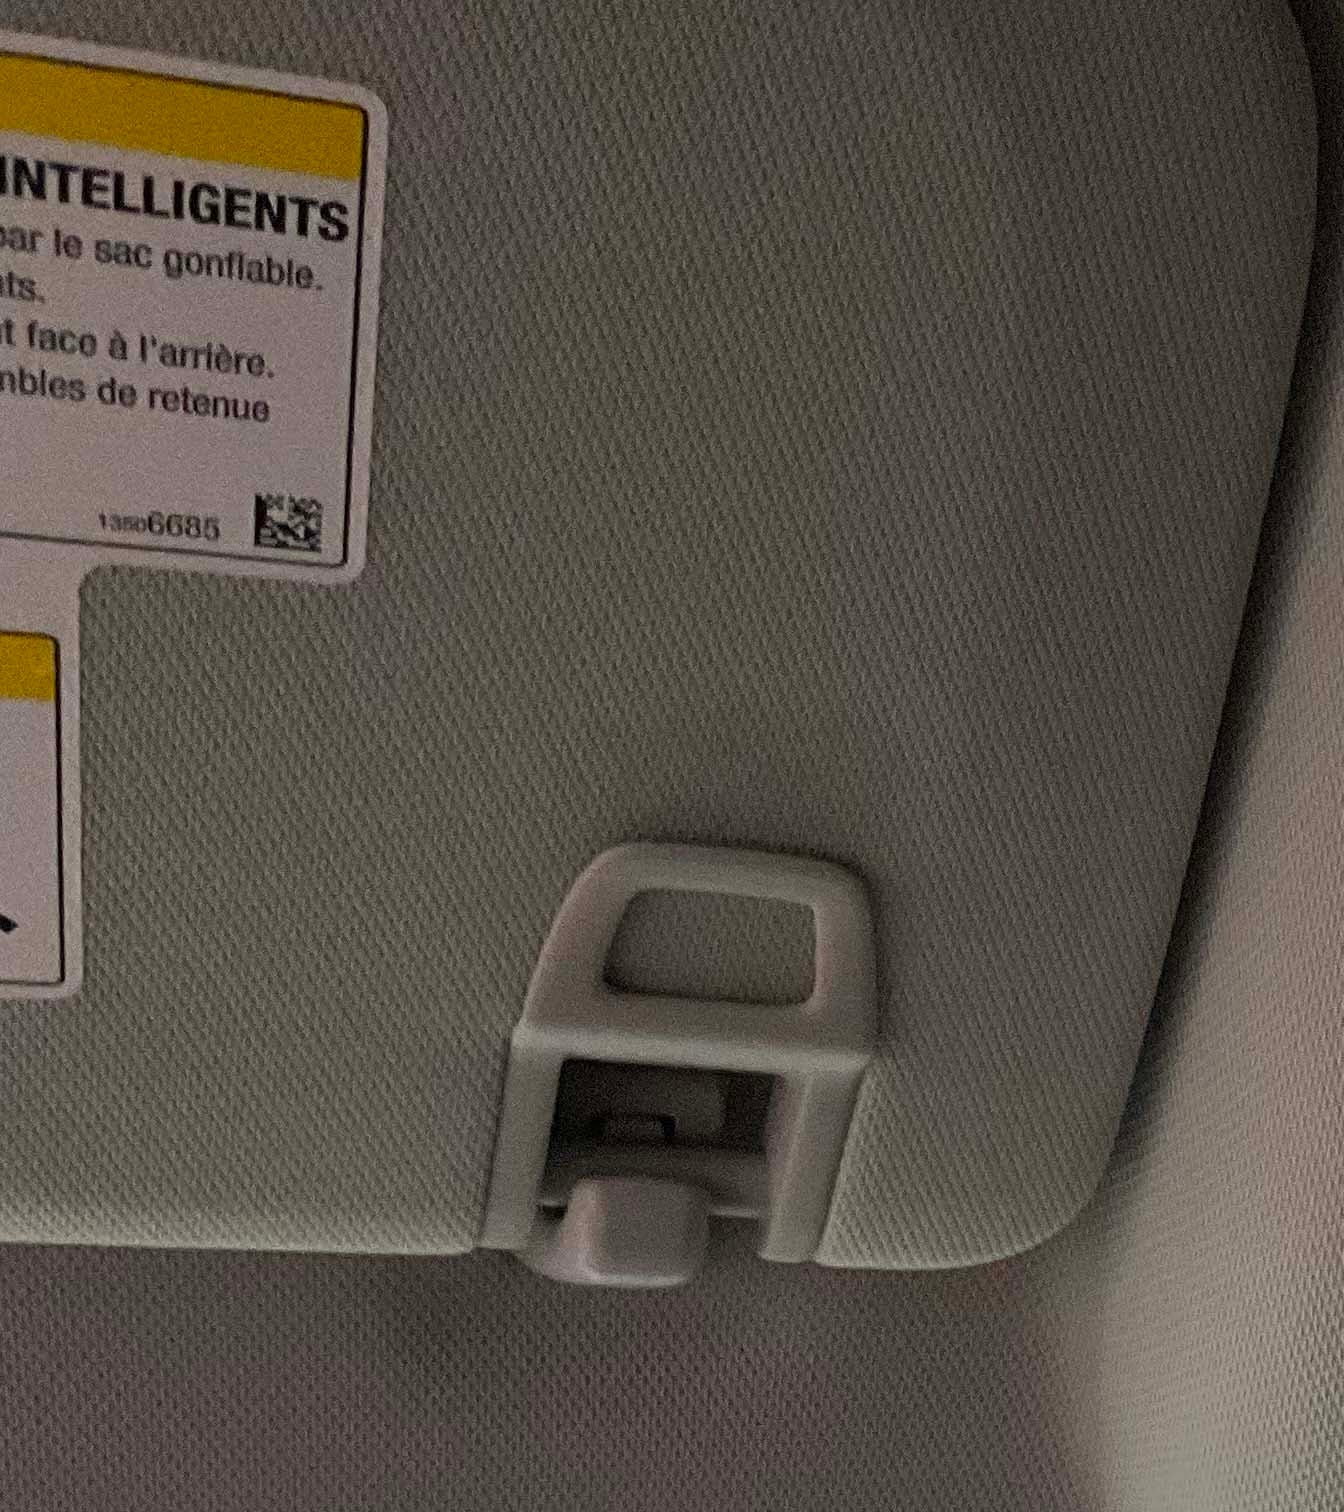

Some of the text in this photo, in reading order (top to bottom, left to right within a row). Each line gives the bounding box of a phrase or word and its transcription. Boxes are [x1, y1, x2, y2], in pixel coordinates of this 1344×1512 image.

[0, 154, 350, 243] INTELLIGENTS
[95, 239, 153, 268] sac
[97, 376, 137, 408] de
[149, 384, 271, 424] retenue
